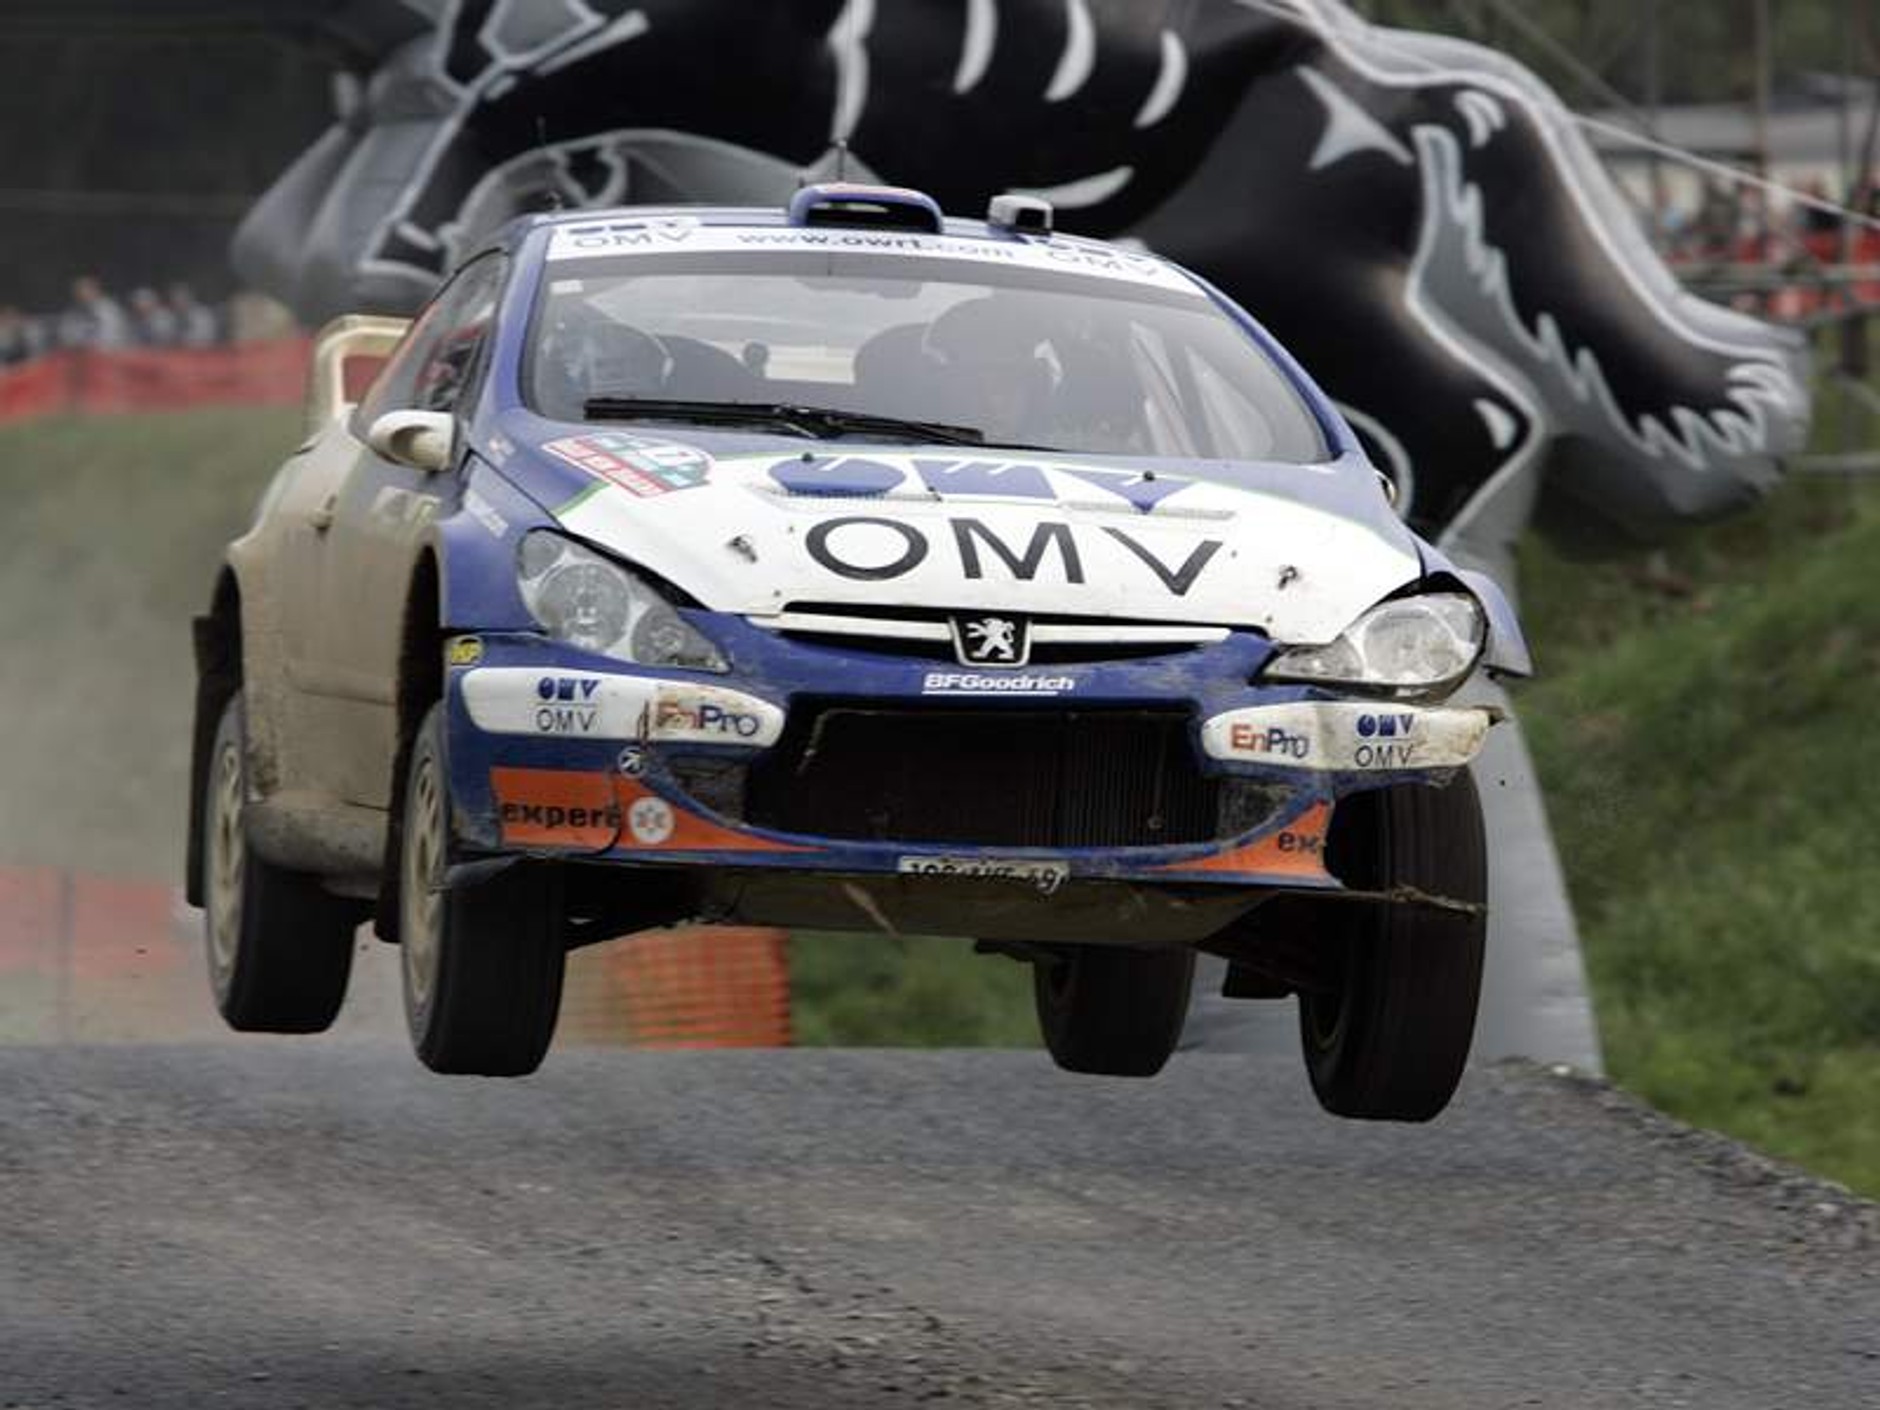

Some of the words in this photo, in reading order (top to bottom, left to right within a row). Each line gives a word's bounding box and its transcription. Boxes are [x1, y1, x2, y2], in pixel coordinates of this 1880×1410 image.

[574, 229, 693, 247] OMV
[805, 516, 1224, 597] OMV
[924, 673, 1075, 690] BFGoodrich
[536, 708, 596, 732] OMV
[656, 700, 758, 737] EnPro
[1231, 723, 1311, 759] EnPro
[1354, 744, 1414, 768] OMV
